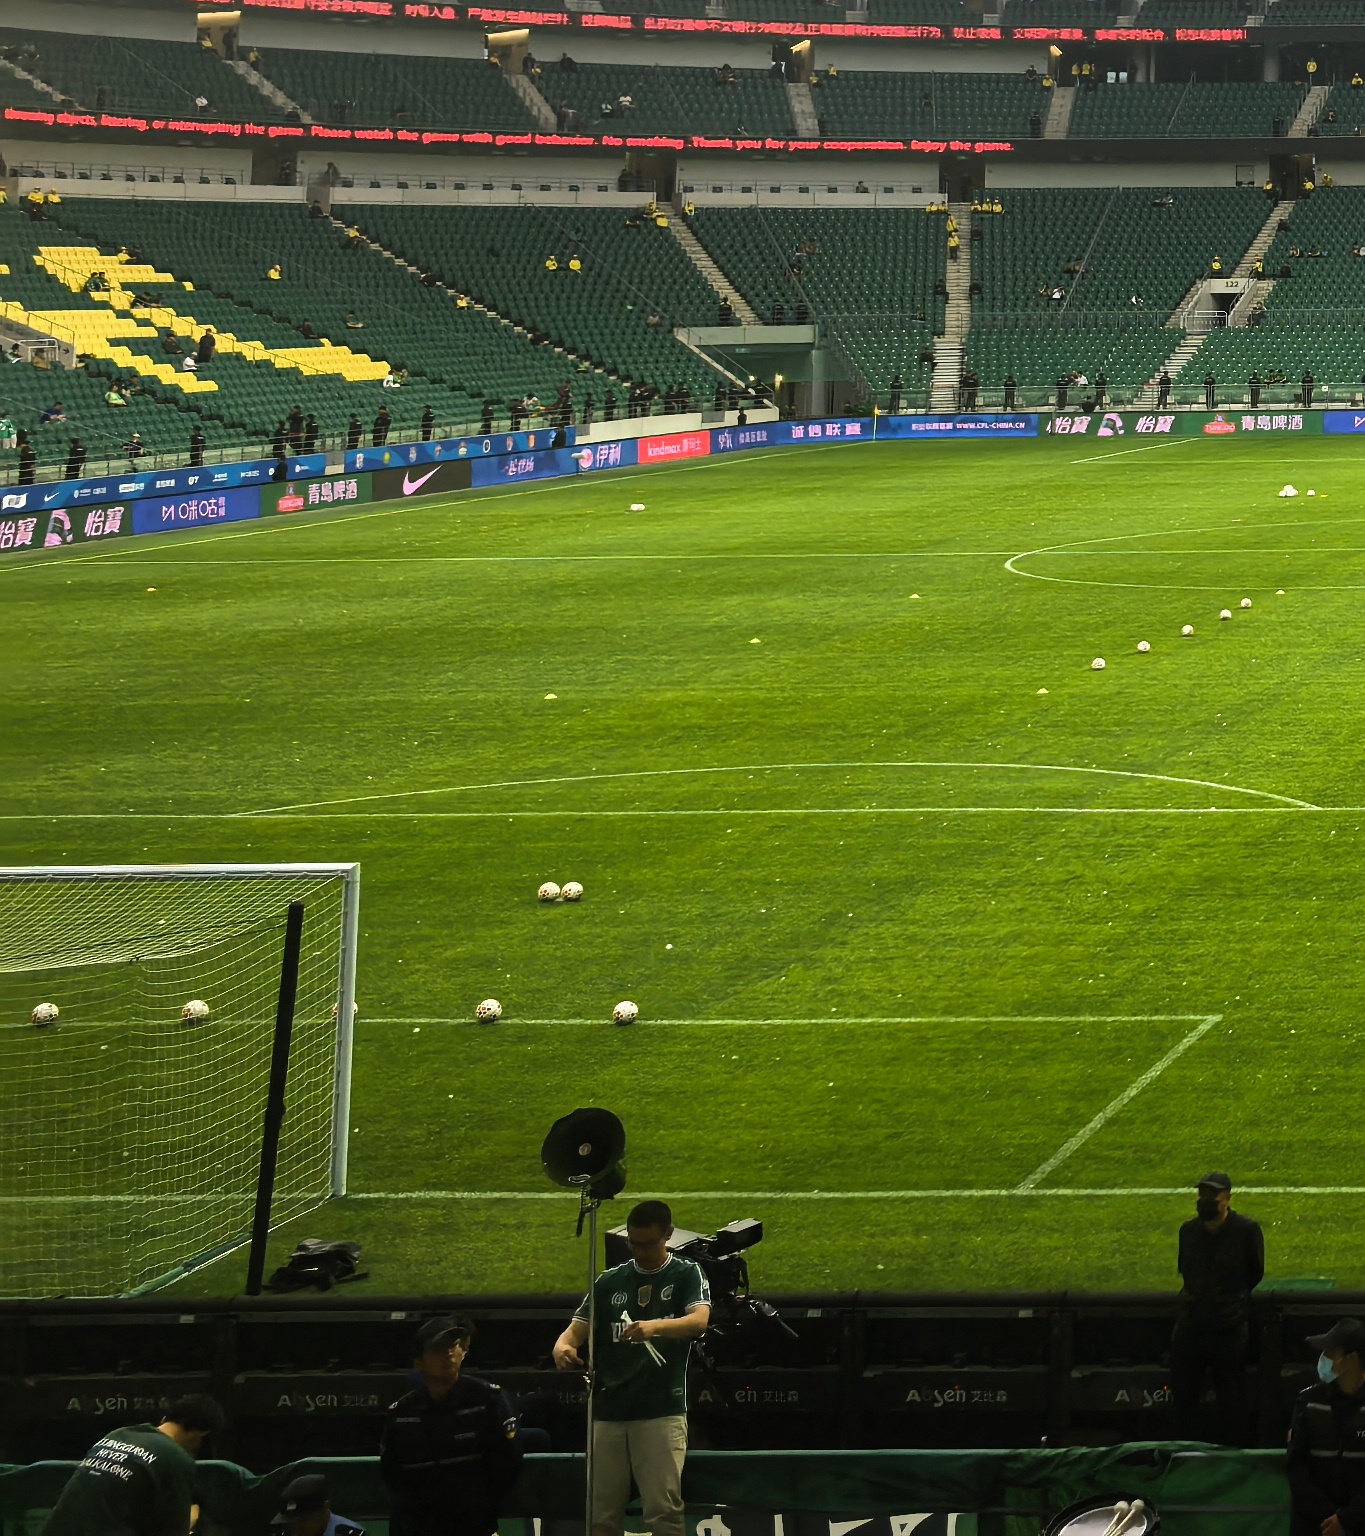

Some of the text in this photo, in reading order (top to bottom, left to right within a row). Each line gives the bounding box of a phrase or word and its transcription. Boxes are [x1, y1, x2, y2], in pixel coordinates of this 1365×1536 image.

[244, 123, 265, 135] the
[735, 139, 762, 151] you
[1225, 281, 1239, 289] 122
[1241, 414, 1303, 431] 青岛啤酒
[647, 441, 682, 459] kindmax
[308, 479, 358, 505] 青岛啤酒
[67, 1393, 127, 1415] Asen
[277, 1393, 338, 1412] Asen
[905, 1387, 967, 1408] Asen
[1115, 1387, 1174, 1408] Asen
